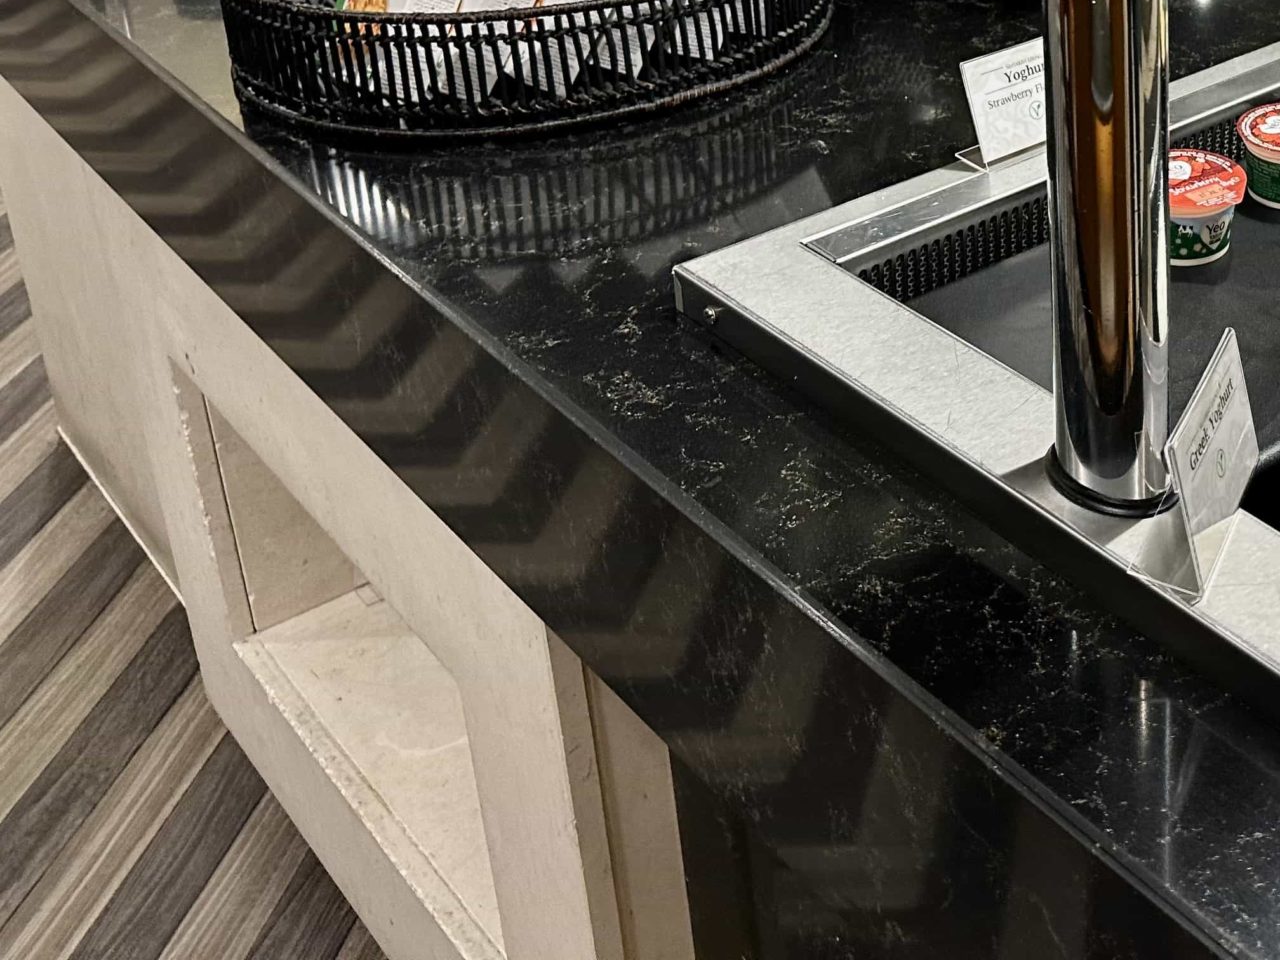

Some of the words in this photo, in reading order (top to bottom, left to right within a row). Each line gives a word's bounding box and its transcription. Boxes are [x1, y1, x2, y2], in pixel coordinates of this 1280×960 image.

[1004, 63, 1044, 83] Yoghu
[987, 87, 1034, 110] Strawberry
[1206, 221, 1226, 235] Yeo
[1189, 426, 1211, 472] Greek
[1208, 378, 1234, 431] Yoghurt
